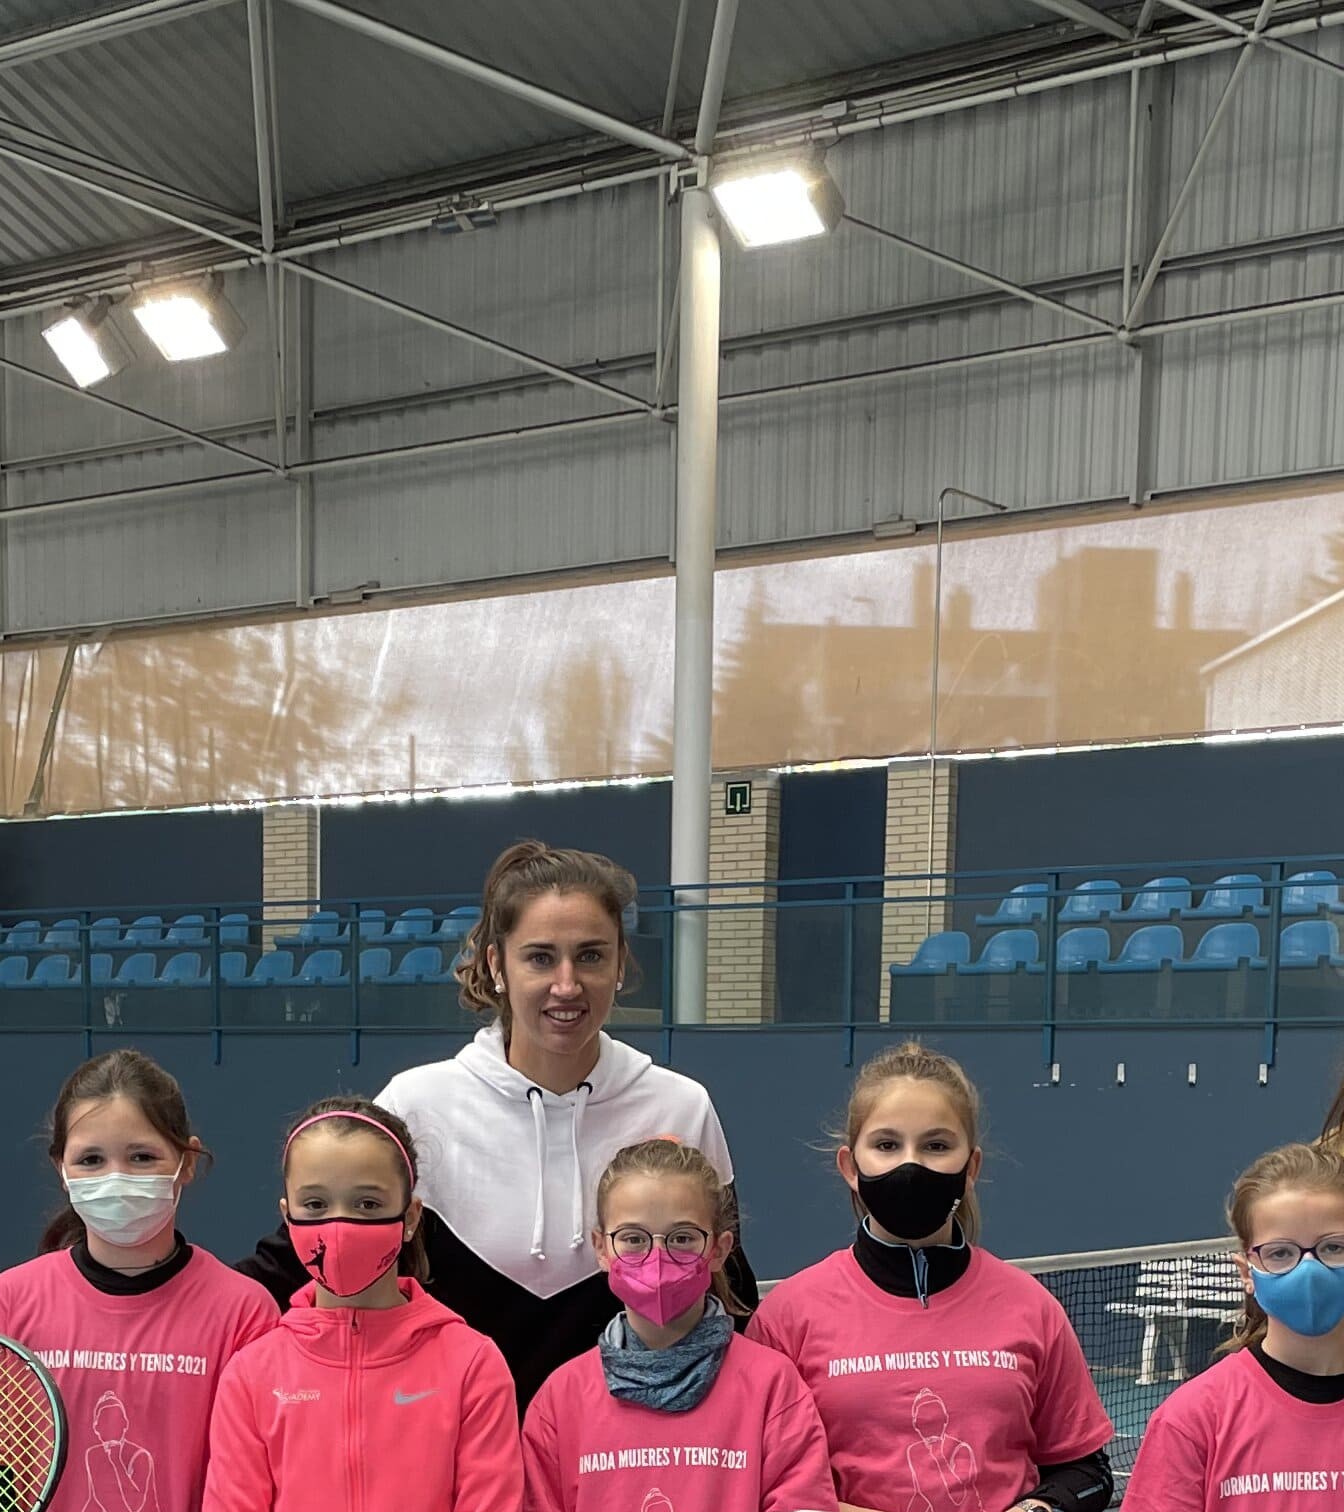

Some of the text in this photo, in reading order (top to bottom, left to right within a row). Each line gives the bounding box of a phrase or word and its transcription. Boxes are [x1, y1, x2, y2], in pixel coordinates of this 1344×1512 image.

[33, 1349, 207, 1376] NADA MUJERES Y TENIS 2021
[828, 1350, 1018, 1378] JORNADA MUJERES Y TENIS 2021
[579, 1447, 747, 1474] NADA MUJERES Y TENIS 2021
[1219, 1472, 1270, 1499] JORNADA
[1272, 1471, 1328, 1491] MUJERES
[1330, 1471, 1339, 1490] Y
